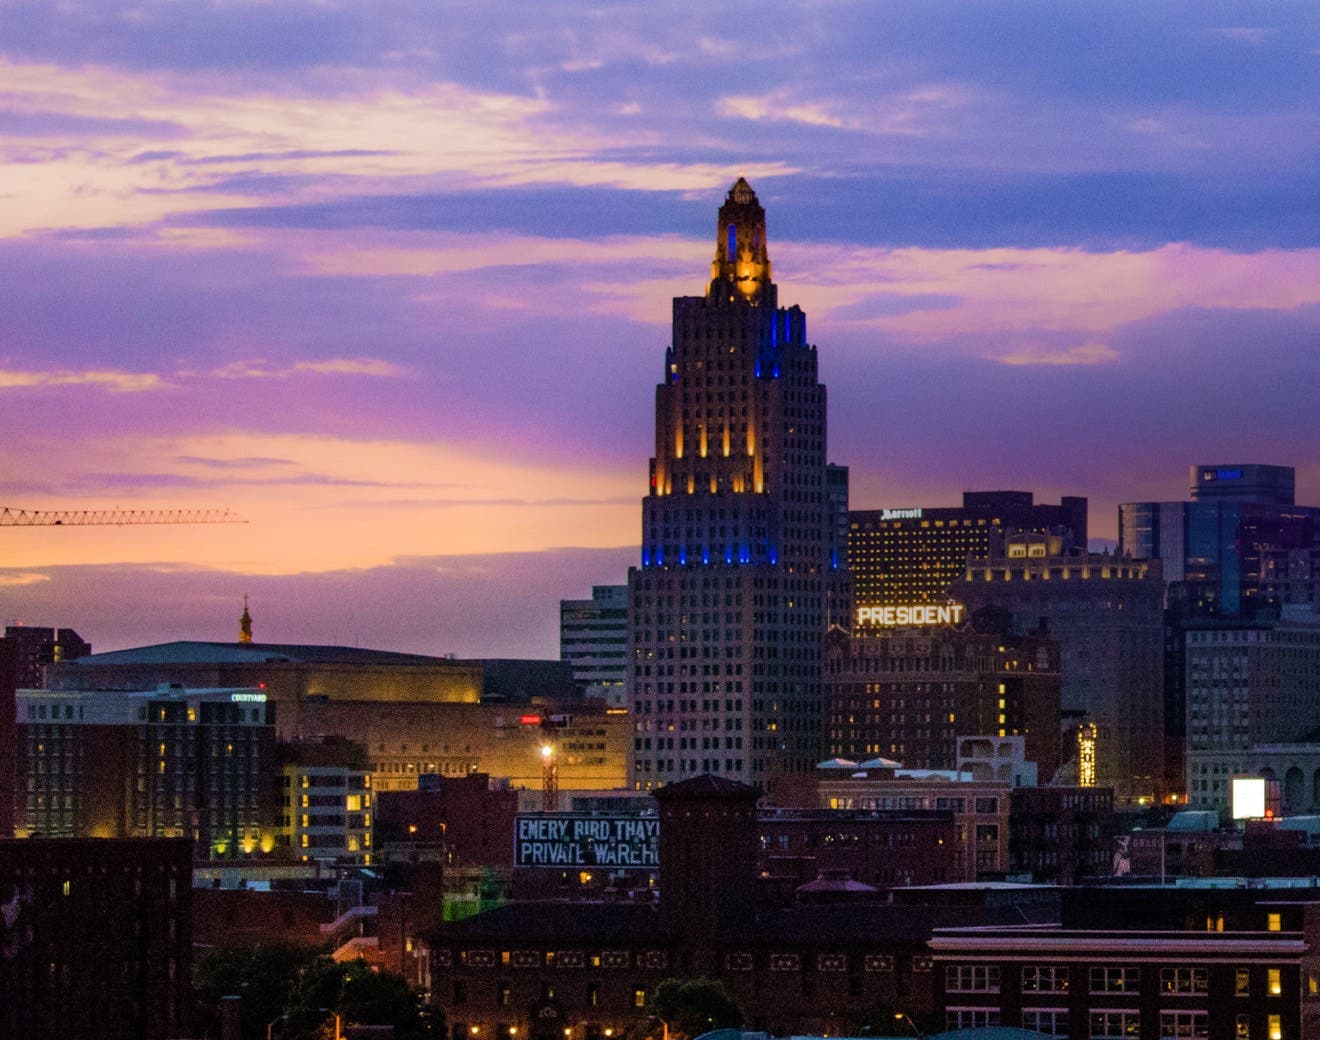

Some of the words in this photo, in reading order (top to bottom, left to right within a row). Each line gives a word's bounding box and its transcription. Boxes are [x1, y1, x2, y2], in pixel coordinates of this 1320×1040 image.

[880, 508, 922, 520] Marriott
[858, 605, 963, 625] PRESIDENT
[519, 819, 569, 840] EMERY
